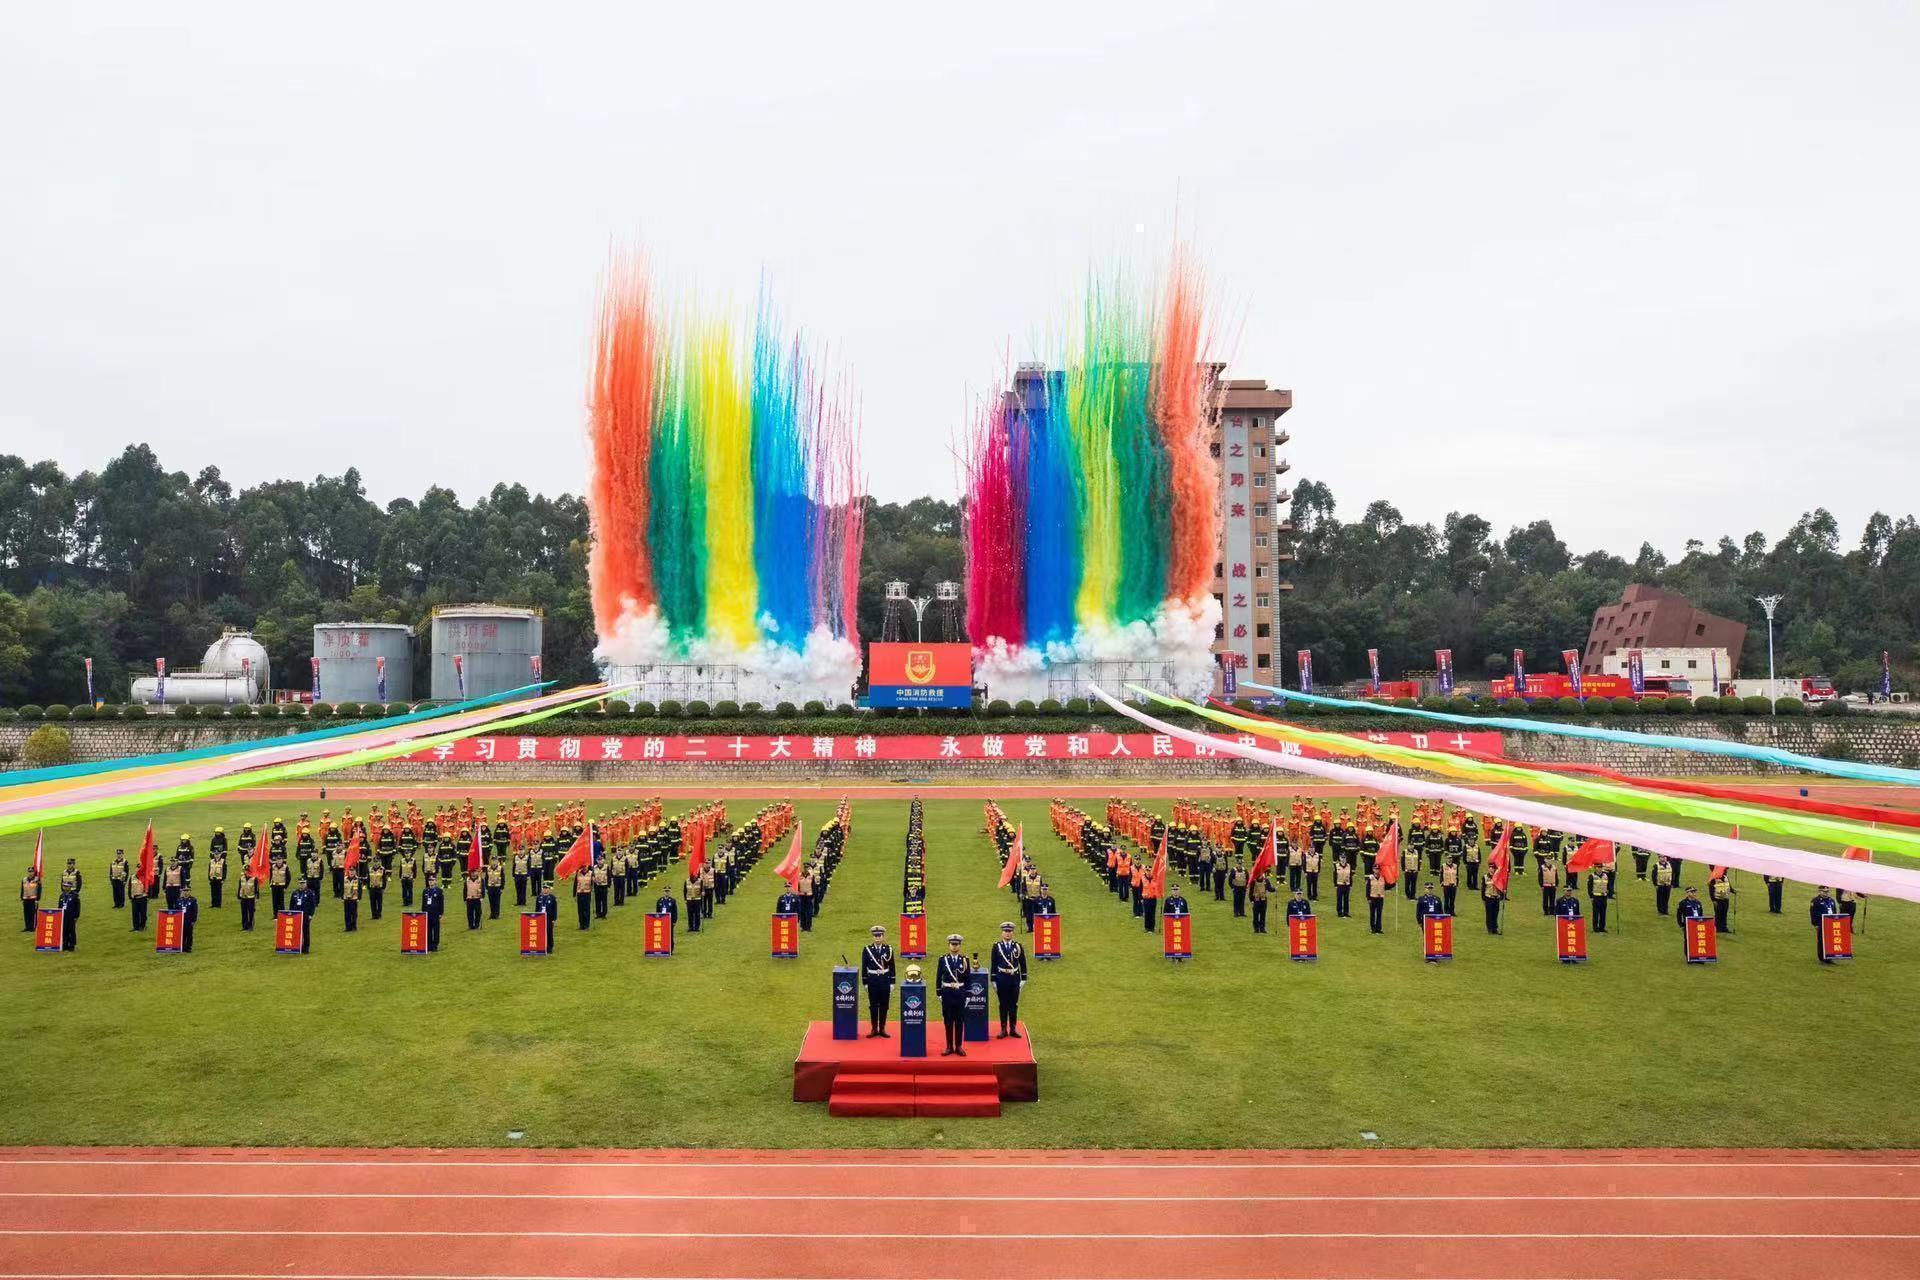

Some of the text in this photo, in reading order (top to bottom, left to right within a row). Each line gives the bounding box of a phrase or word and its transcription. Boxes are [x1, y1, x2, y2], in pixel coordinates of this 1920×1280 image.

[352, 732, 1473, 758] 学习贯彻党的二十大精神 永做党和人民的忠诚卫士
